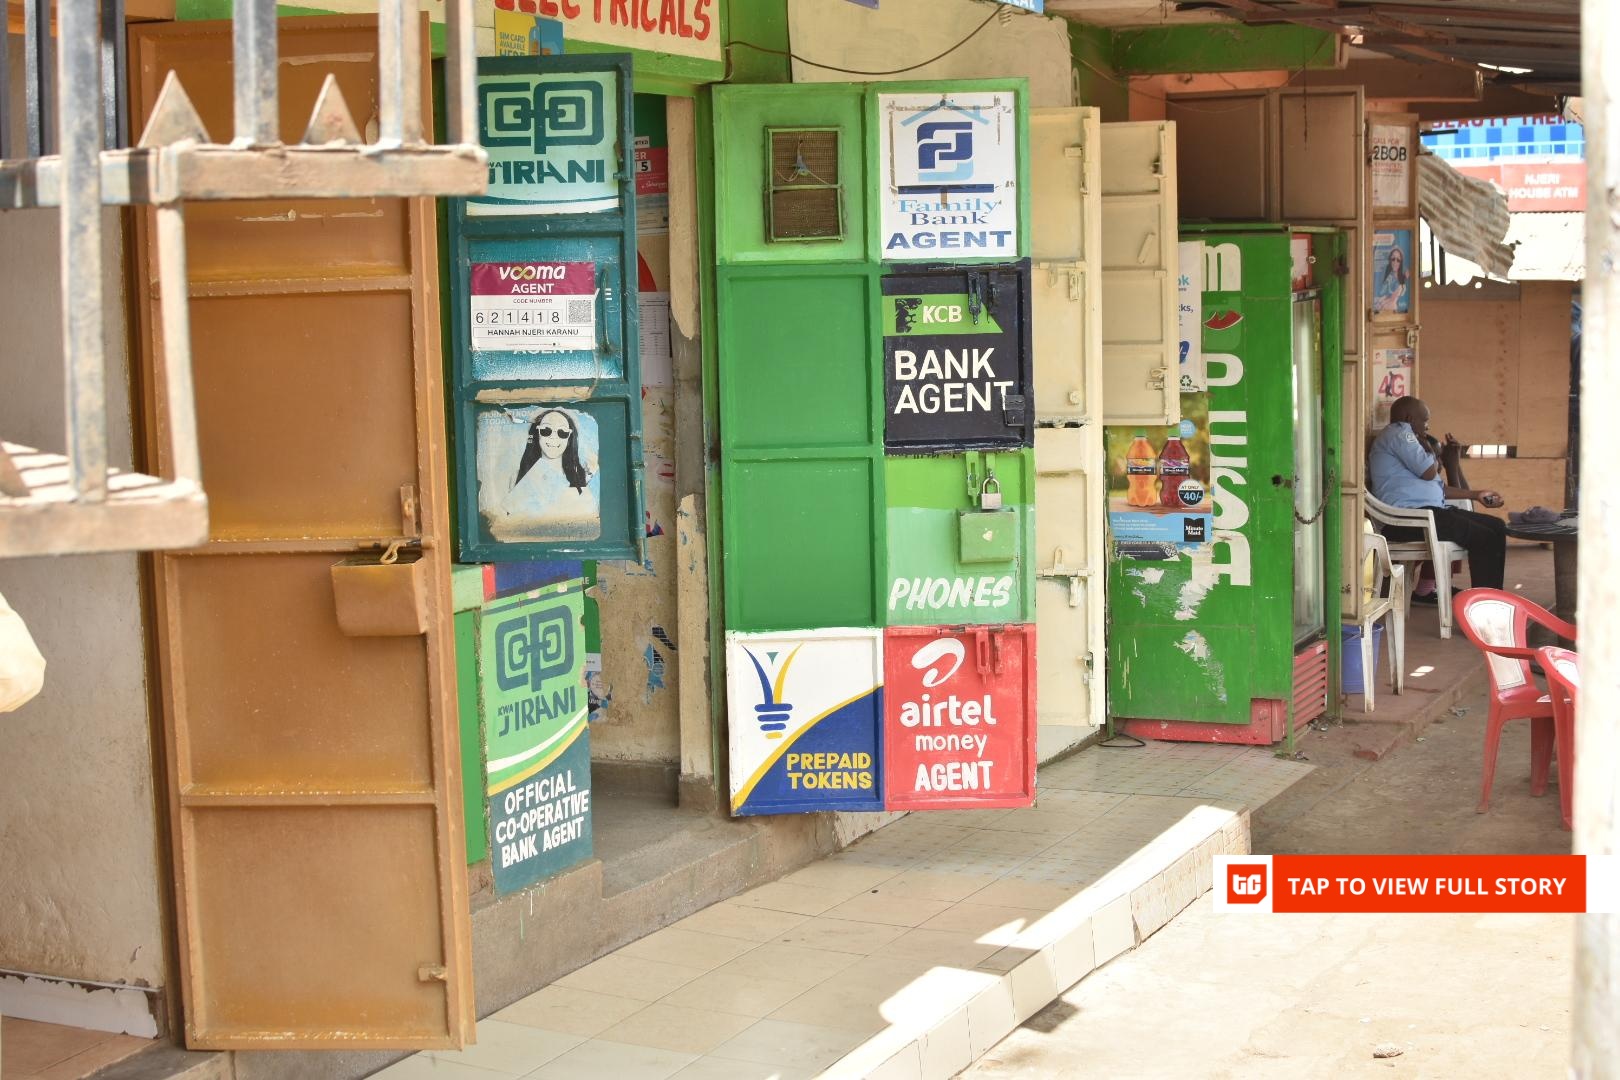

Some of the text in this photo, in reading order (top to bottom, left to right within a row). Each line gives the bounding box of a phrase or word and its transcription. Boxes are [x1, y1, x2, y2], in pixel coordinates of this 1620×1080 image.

[494, 0, 711, 41] TRICALS
[1524, 173, 1560, 185] NJERI
[1508, 187, 1551, 199] HOUSE
[898, 198, 998, 214] Family
[911, 211, 989, 226] Bank
[886, 230, 1012, 250] AGENT
[499, 265, 566, 281] vooma
[511, 283, 555, 294] AGENT
[922, 305, 963, 324] KCB
[487, 329, 521, 337] HANNAH
[546, 328, 579, 336] KARANU
[894, 347, 996, 381] BANK
[893, 380, 1014, 415] AGENT
[889, 576, 1013, 610] PHONES
[497, 702, 514, 717] KWA
[499, 686, 576, 737] JIRANI
[900, 693, 997, 728] airtel
[915, 733, 988, 758] money
[786, 752, 872, 771] PREPAID
[787, 771, 873, 790] TOKENS
[914, 760, 994, 793] AGENT
[504, 771, 576, 813] OFFICIAL
[495, 790, 590, 844] CO-OPERATIVE
[501, 817, 584, 869] BANK AGENT
